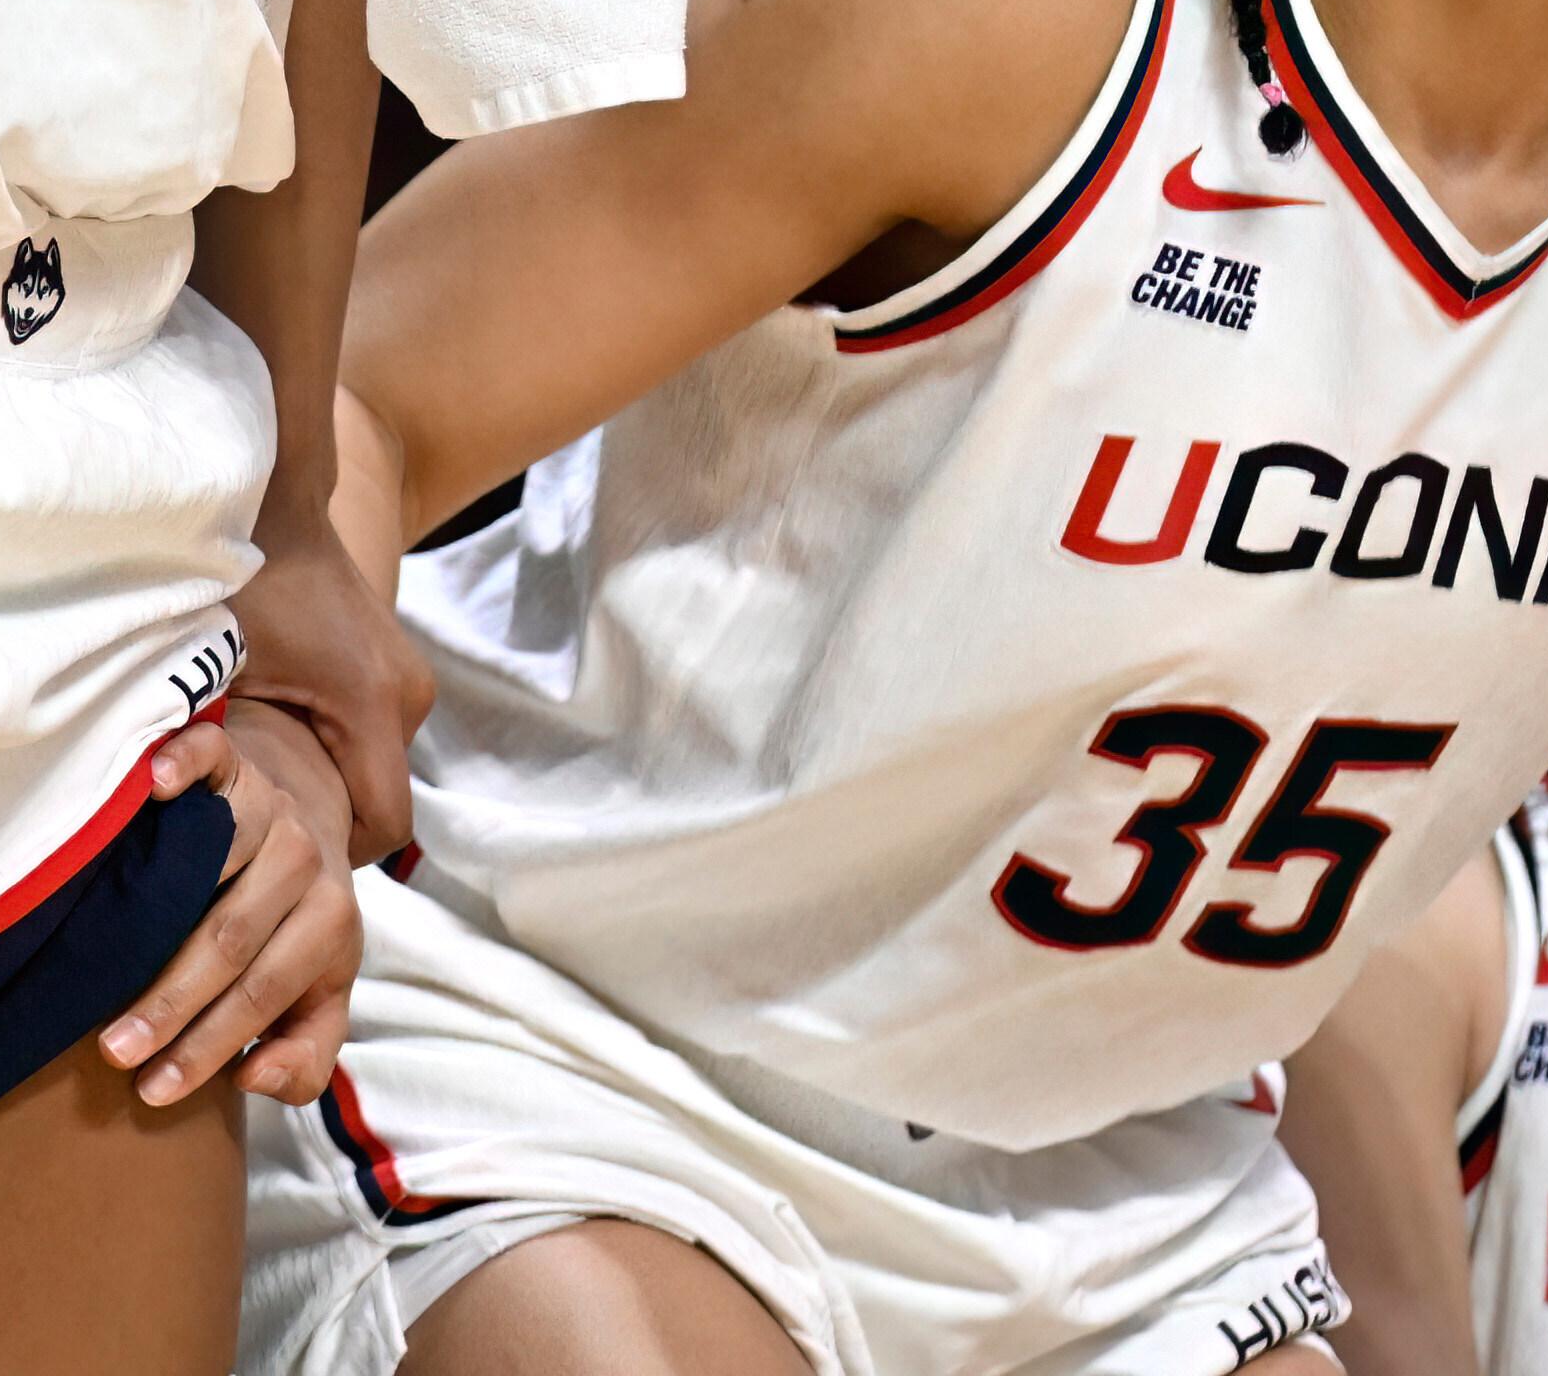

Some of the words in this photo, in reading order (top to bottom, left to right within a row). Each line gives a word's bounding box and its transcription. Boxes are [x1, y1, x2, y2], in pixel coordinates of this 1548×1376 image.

[1152, 242, 1205, 282] BE
[1209, 256, 1262, 298] THE
[1131, 272, 1257, 331] CHANGE
[990, 703, 1459, 969] 35
